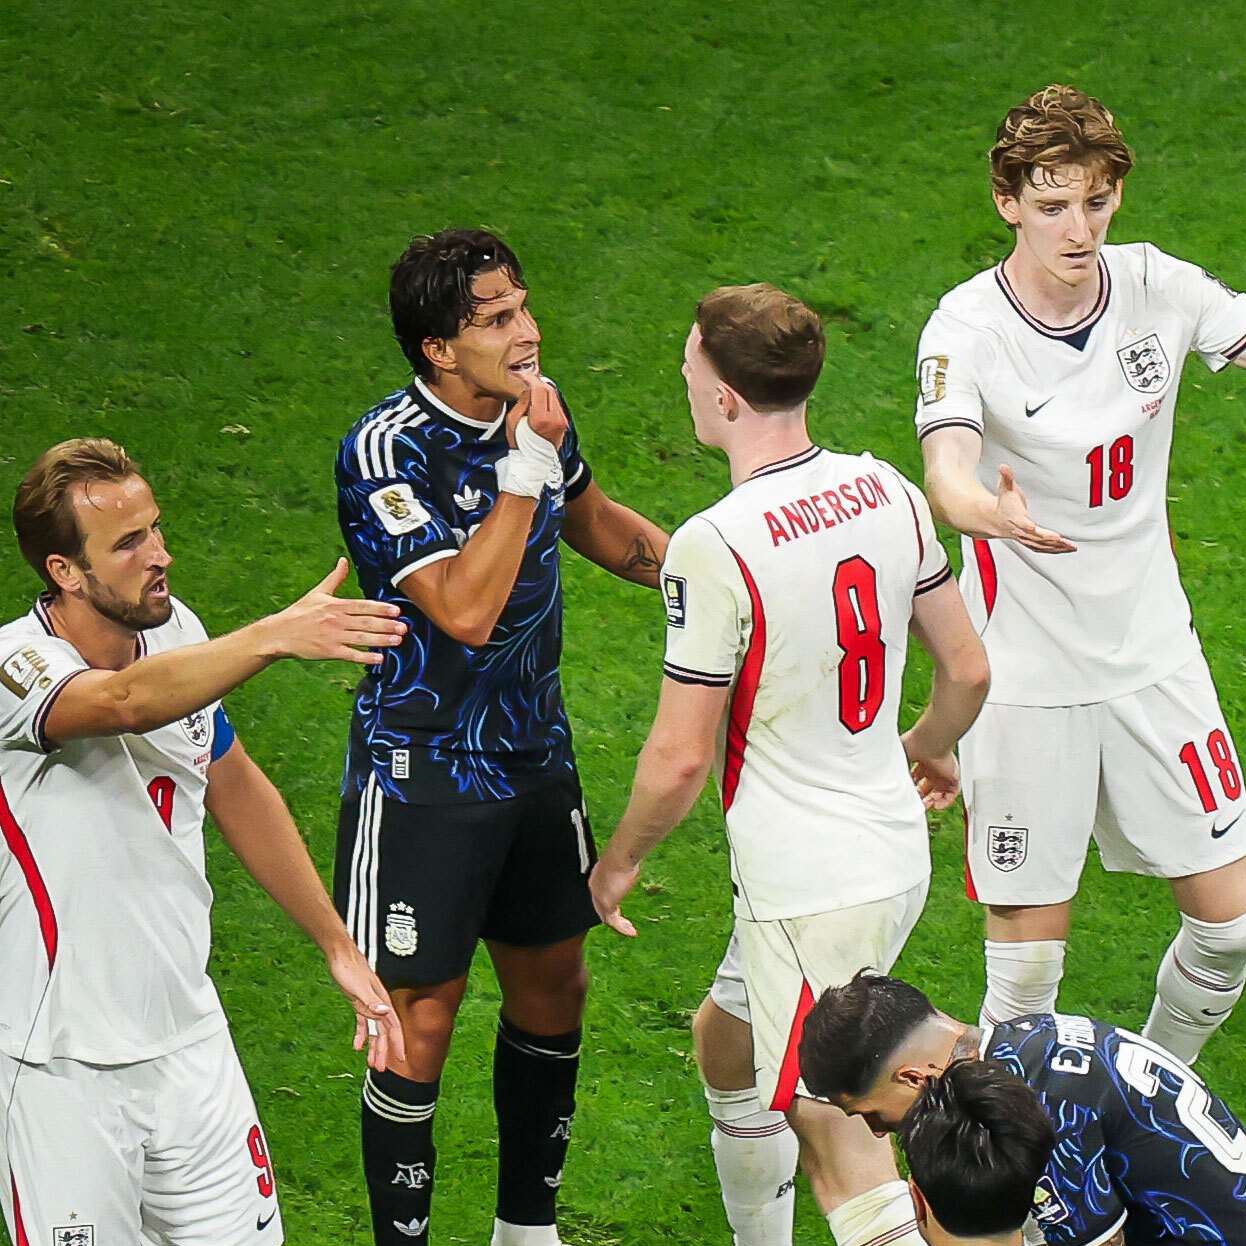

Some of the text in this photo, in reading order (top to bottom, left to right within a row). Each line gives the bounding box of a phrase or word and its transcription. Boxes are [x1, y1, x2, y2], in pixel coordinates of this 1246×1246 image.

[1085, 434, 1134, 508] 18
[764, 472, 891, 547] ANDERSON
[833, 554, 886, 735] 8
[1179, 728, 1241, 813] 18
[247, 1124, 273, 1198] 9
